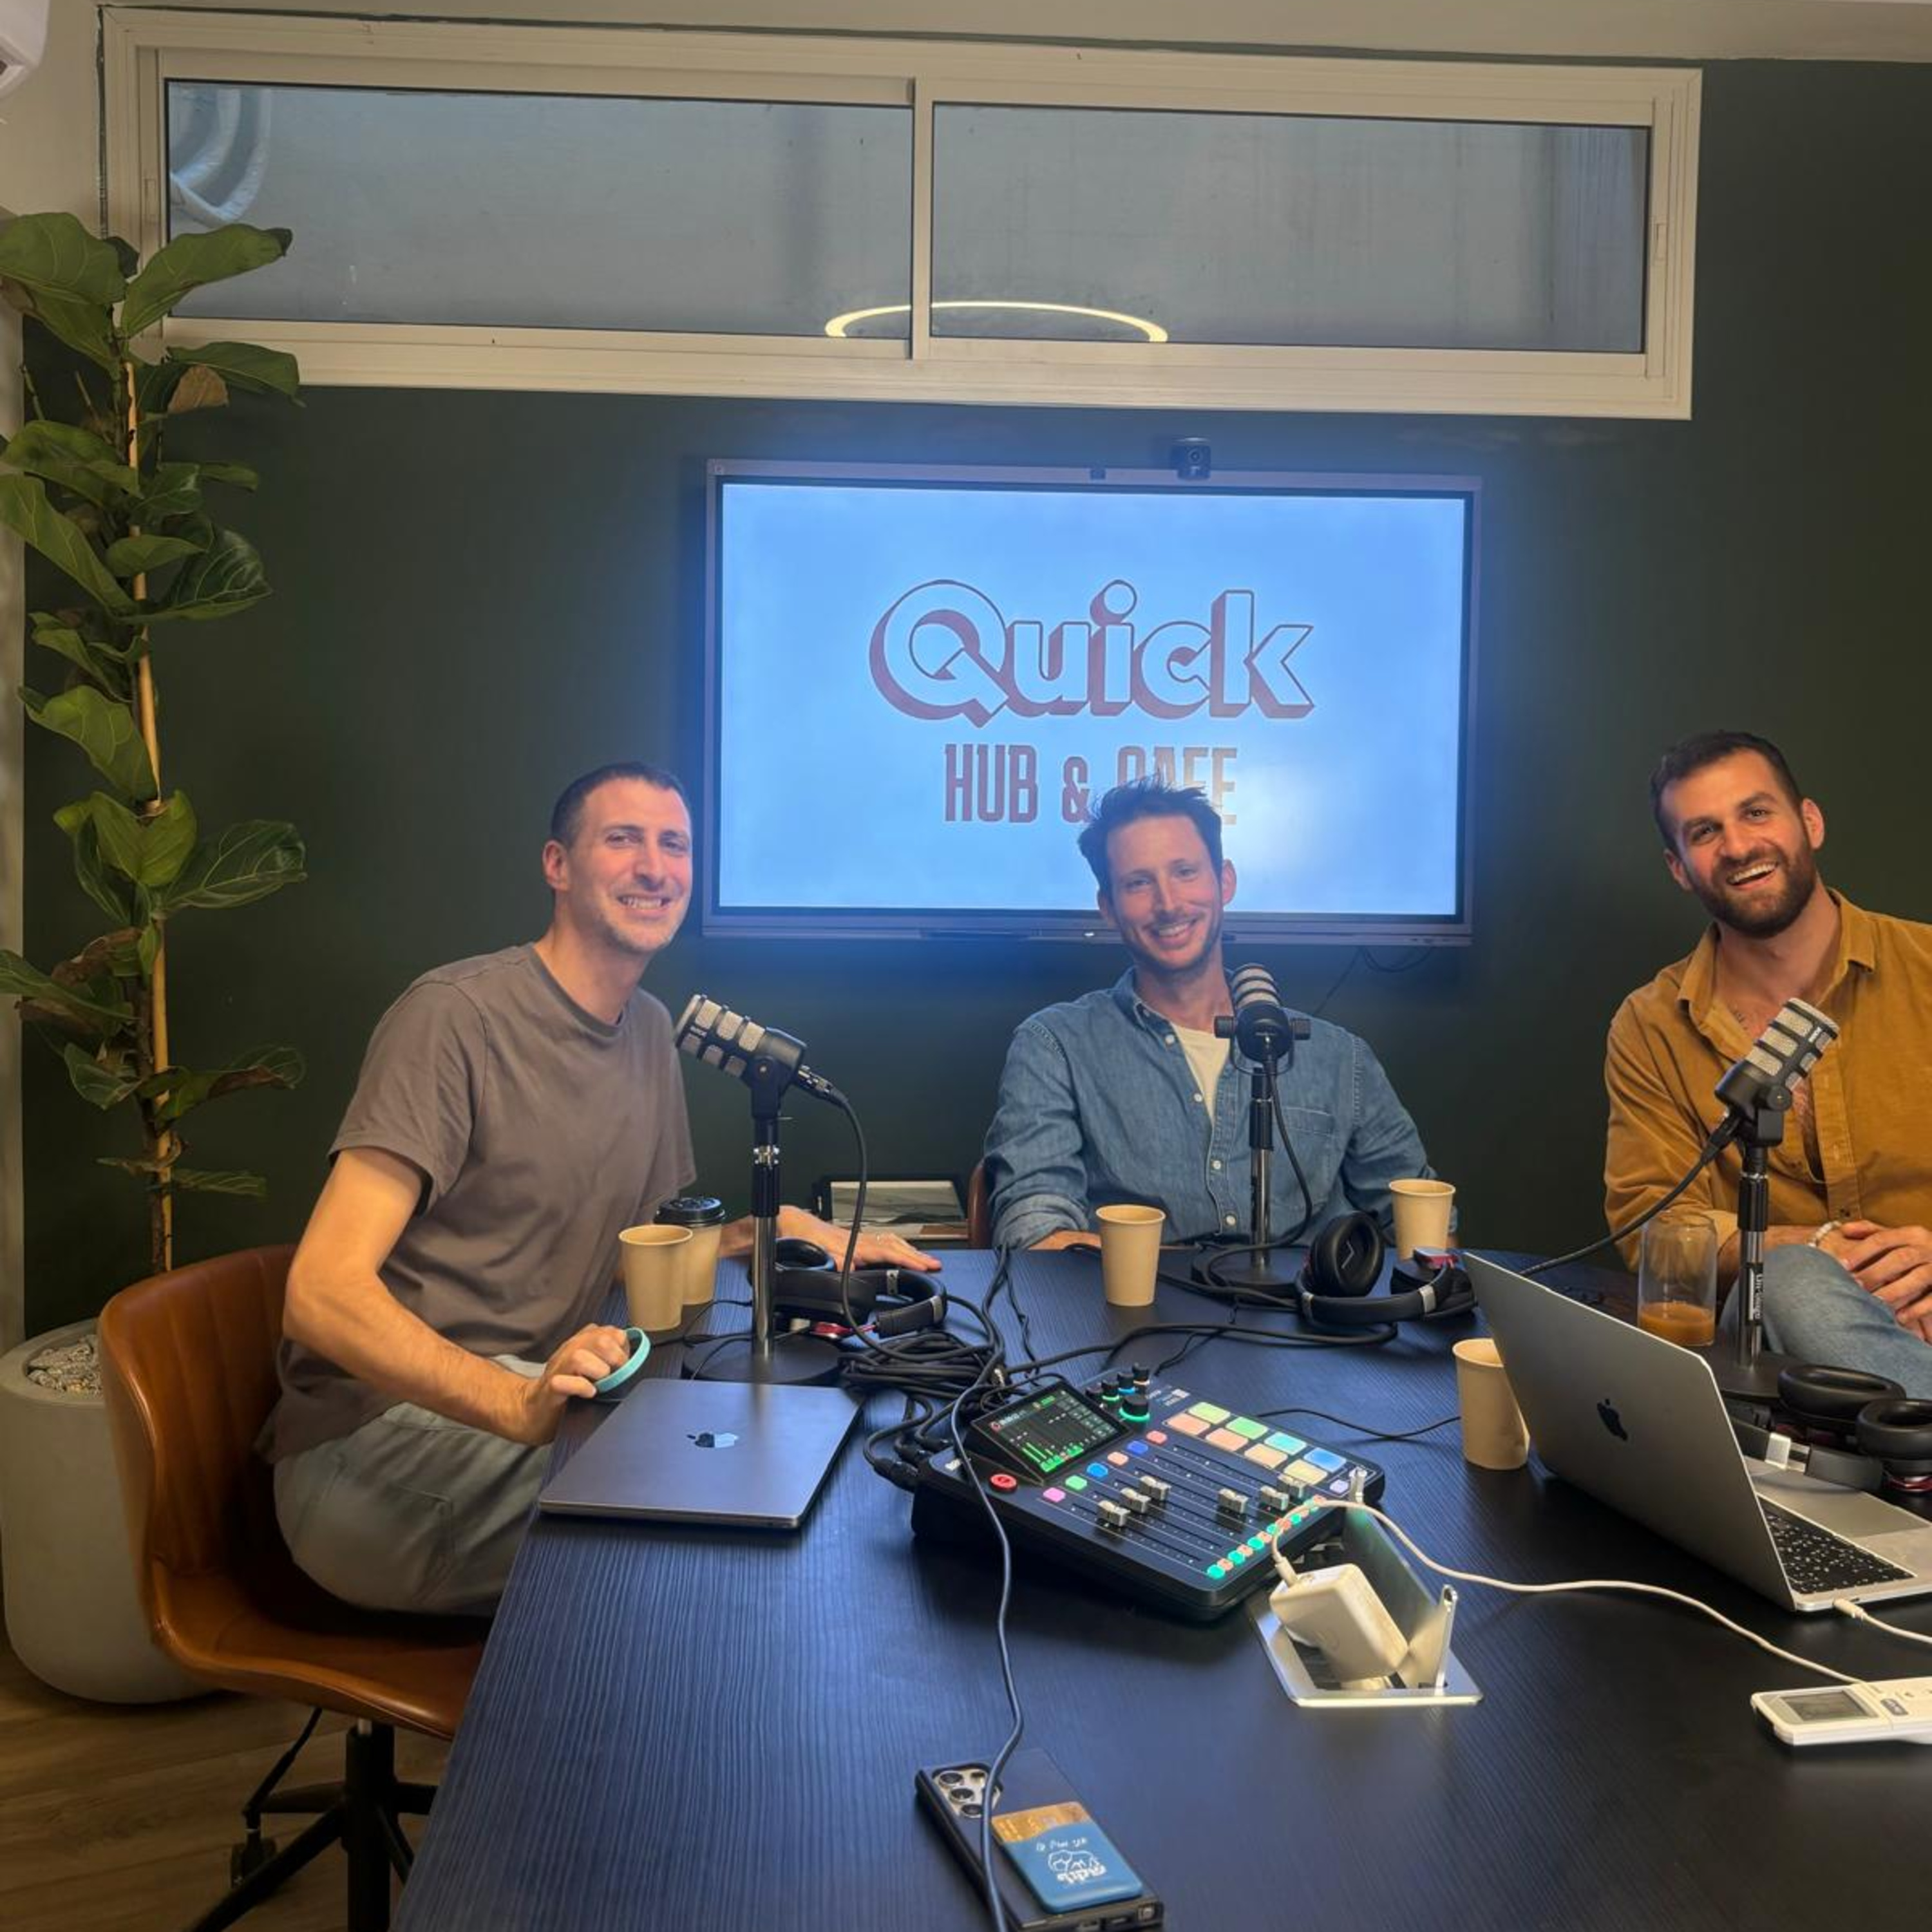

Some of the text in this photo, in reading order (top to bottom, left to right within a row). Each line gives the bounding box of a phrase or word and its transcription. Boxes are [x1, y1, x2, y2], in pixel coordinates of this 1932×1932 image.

[869, 579, 1314, 728] Quick
[945, 744, 1038, 823] HUB
[1062, 756, 1090, 824] &
